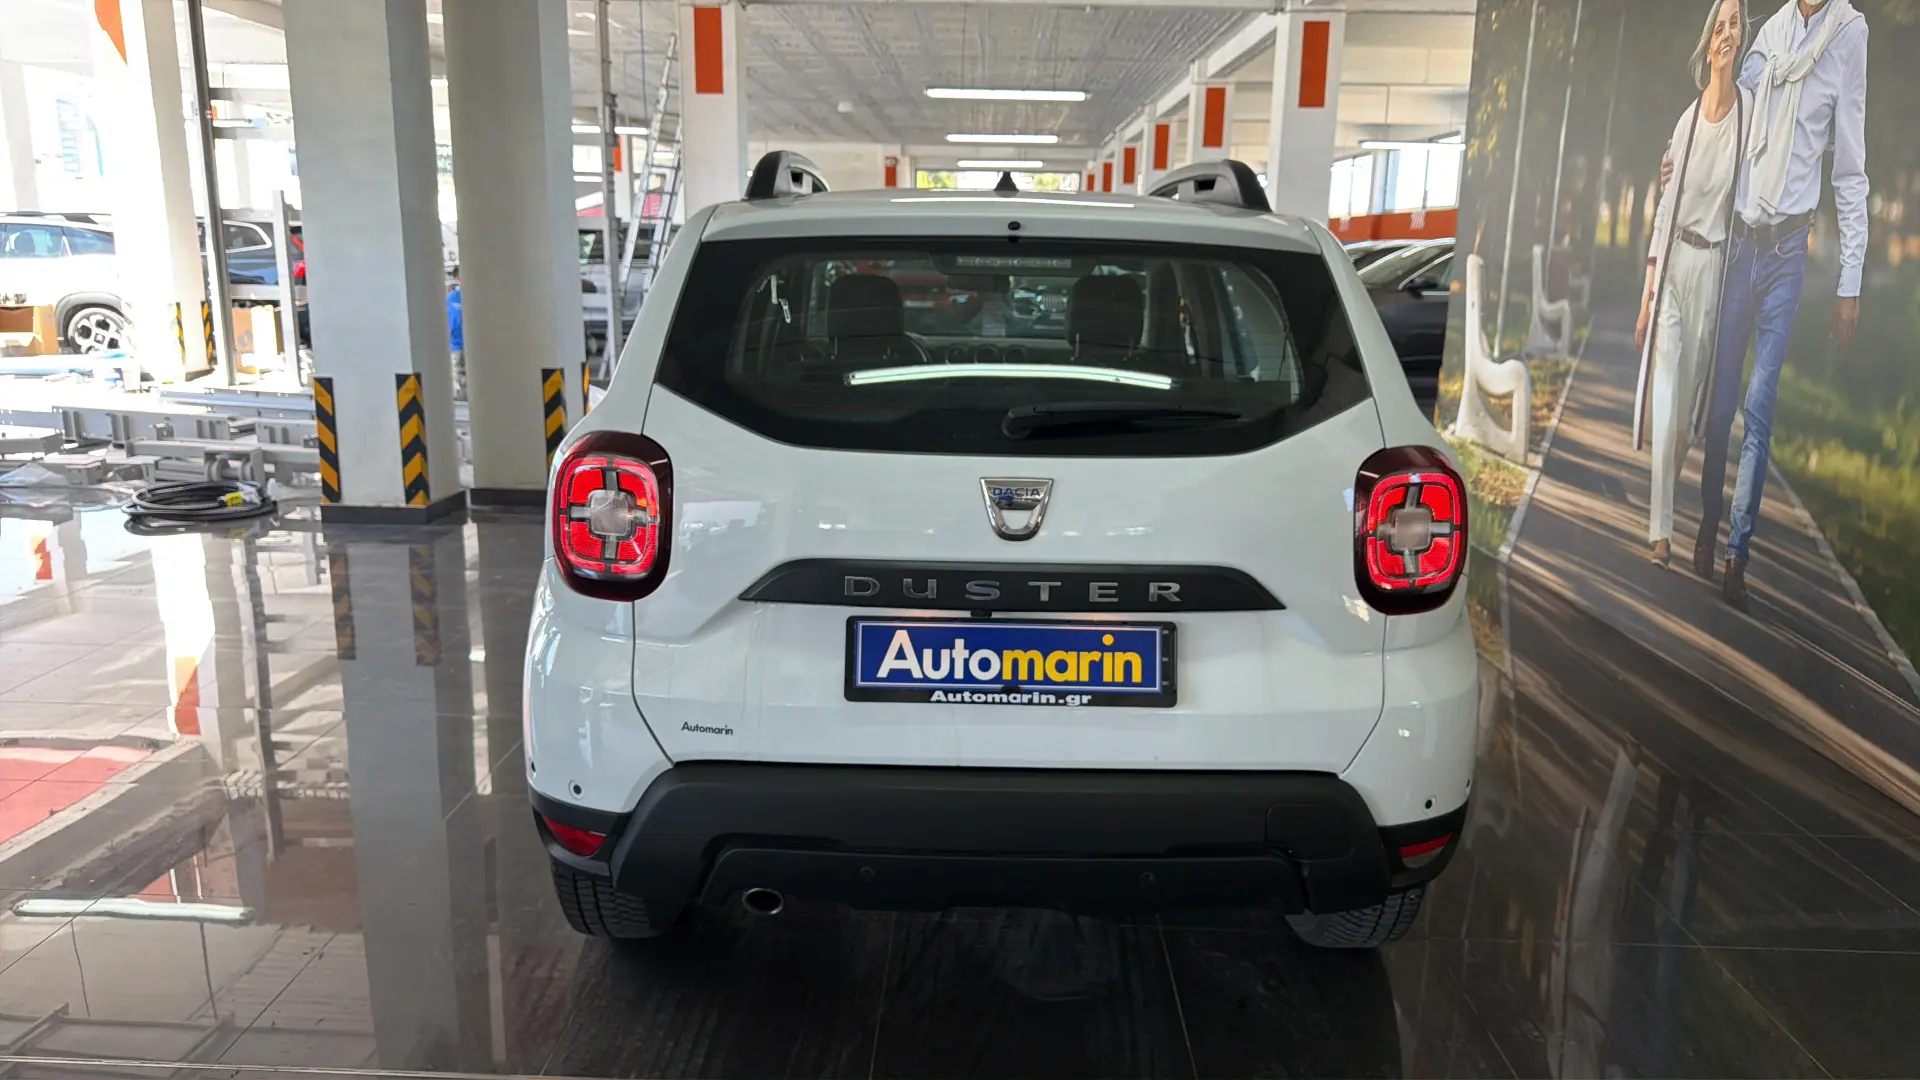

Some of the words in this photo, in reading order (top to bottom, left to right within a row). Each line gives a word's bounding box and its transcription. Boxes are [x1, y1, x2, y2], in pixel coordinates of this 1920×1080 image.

[993, 487, 1041, 497] DACIA
[844, 575, 1183, 602] DUSTER
[876, 629, 1143, 684] Automarin
[929, 690, 1092, 706] Automarin.gr
[681, 720, 734, 736] Automarin
